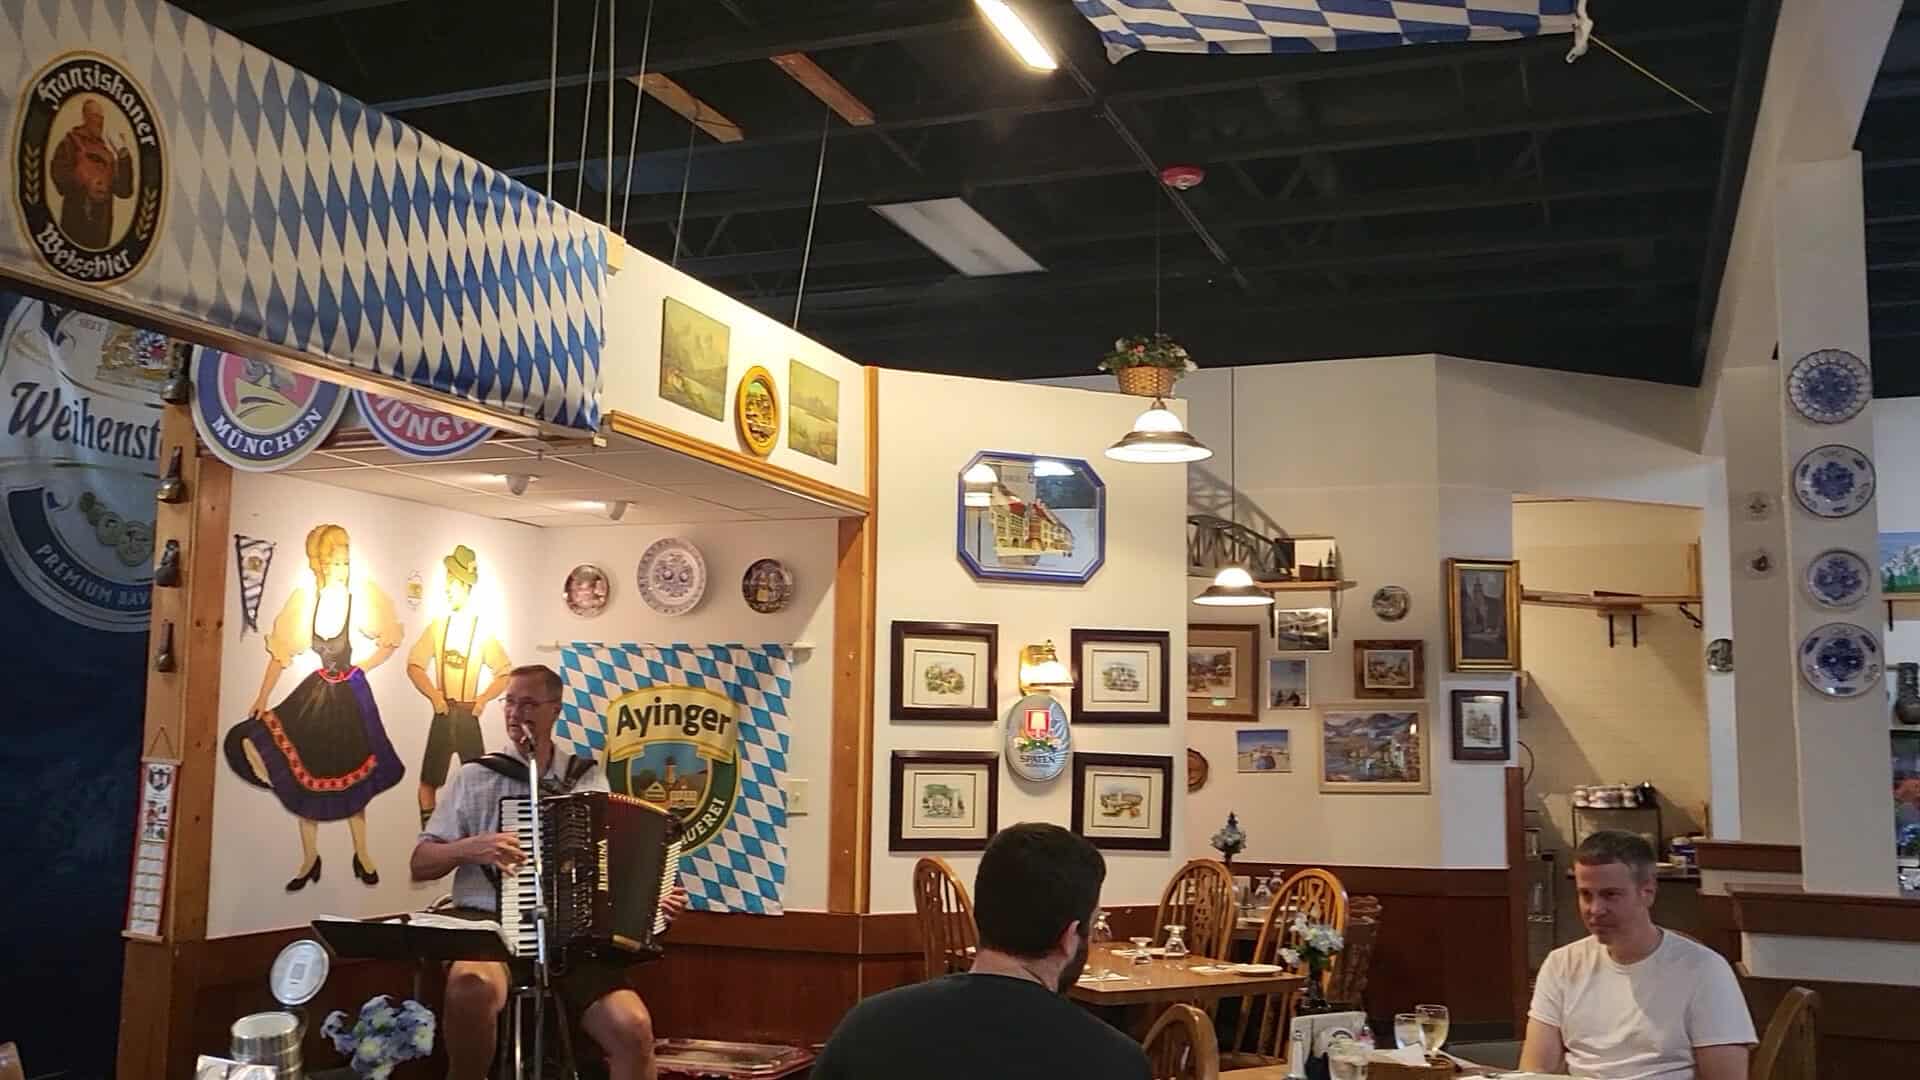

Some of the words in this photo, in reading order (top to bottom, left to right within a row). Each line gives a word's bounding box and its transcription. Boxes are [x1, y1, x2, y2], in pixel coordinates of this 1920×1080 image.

[37, 64, 157, 148] Franziskaner
[211, 407, 323, 456] MÜNCHEN
[35, 543, 113, 603] PREMIUM
[615, 696, 732, 738] Ayinger
